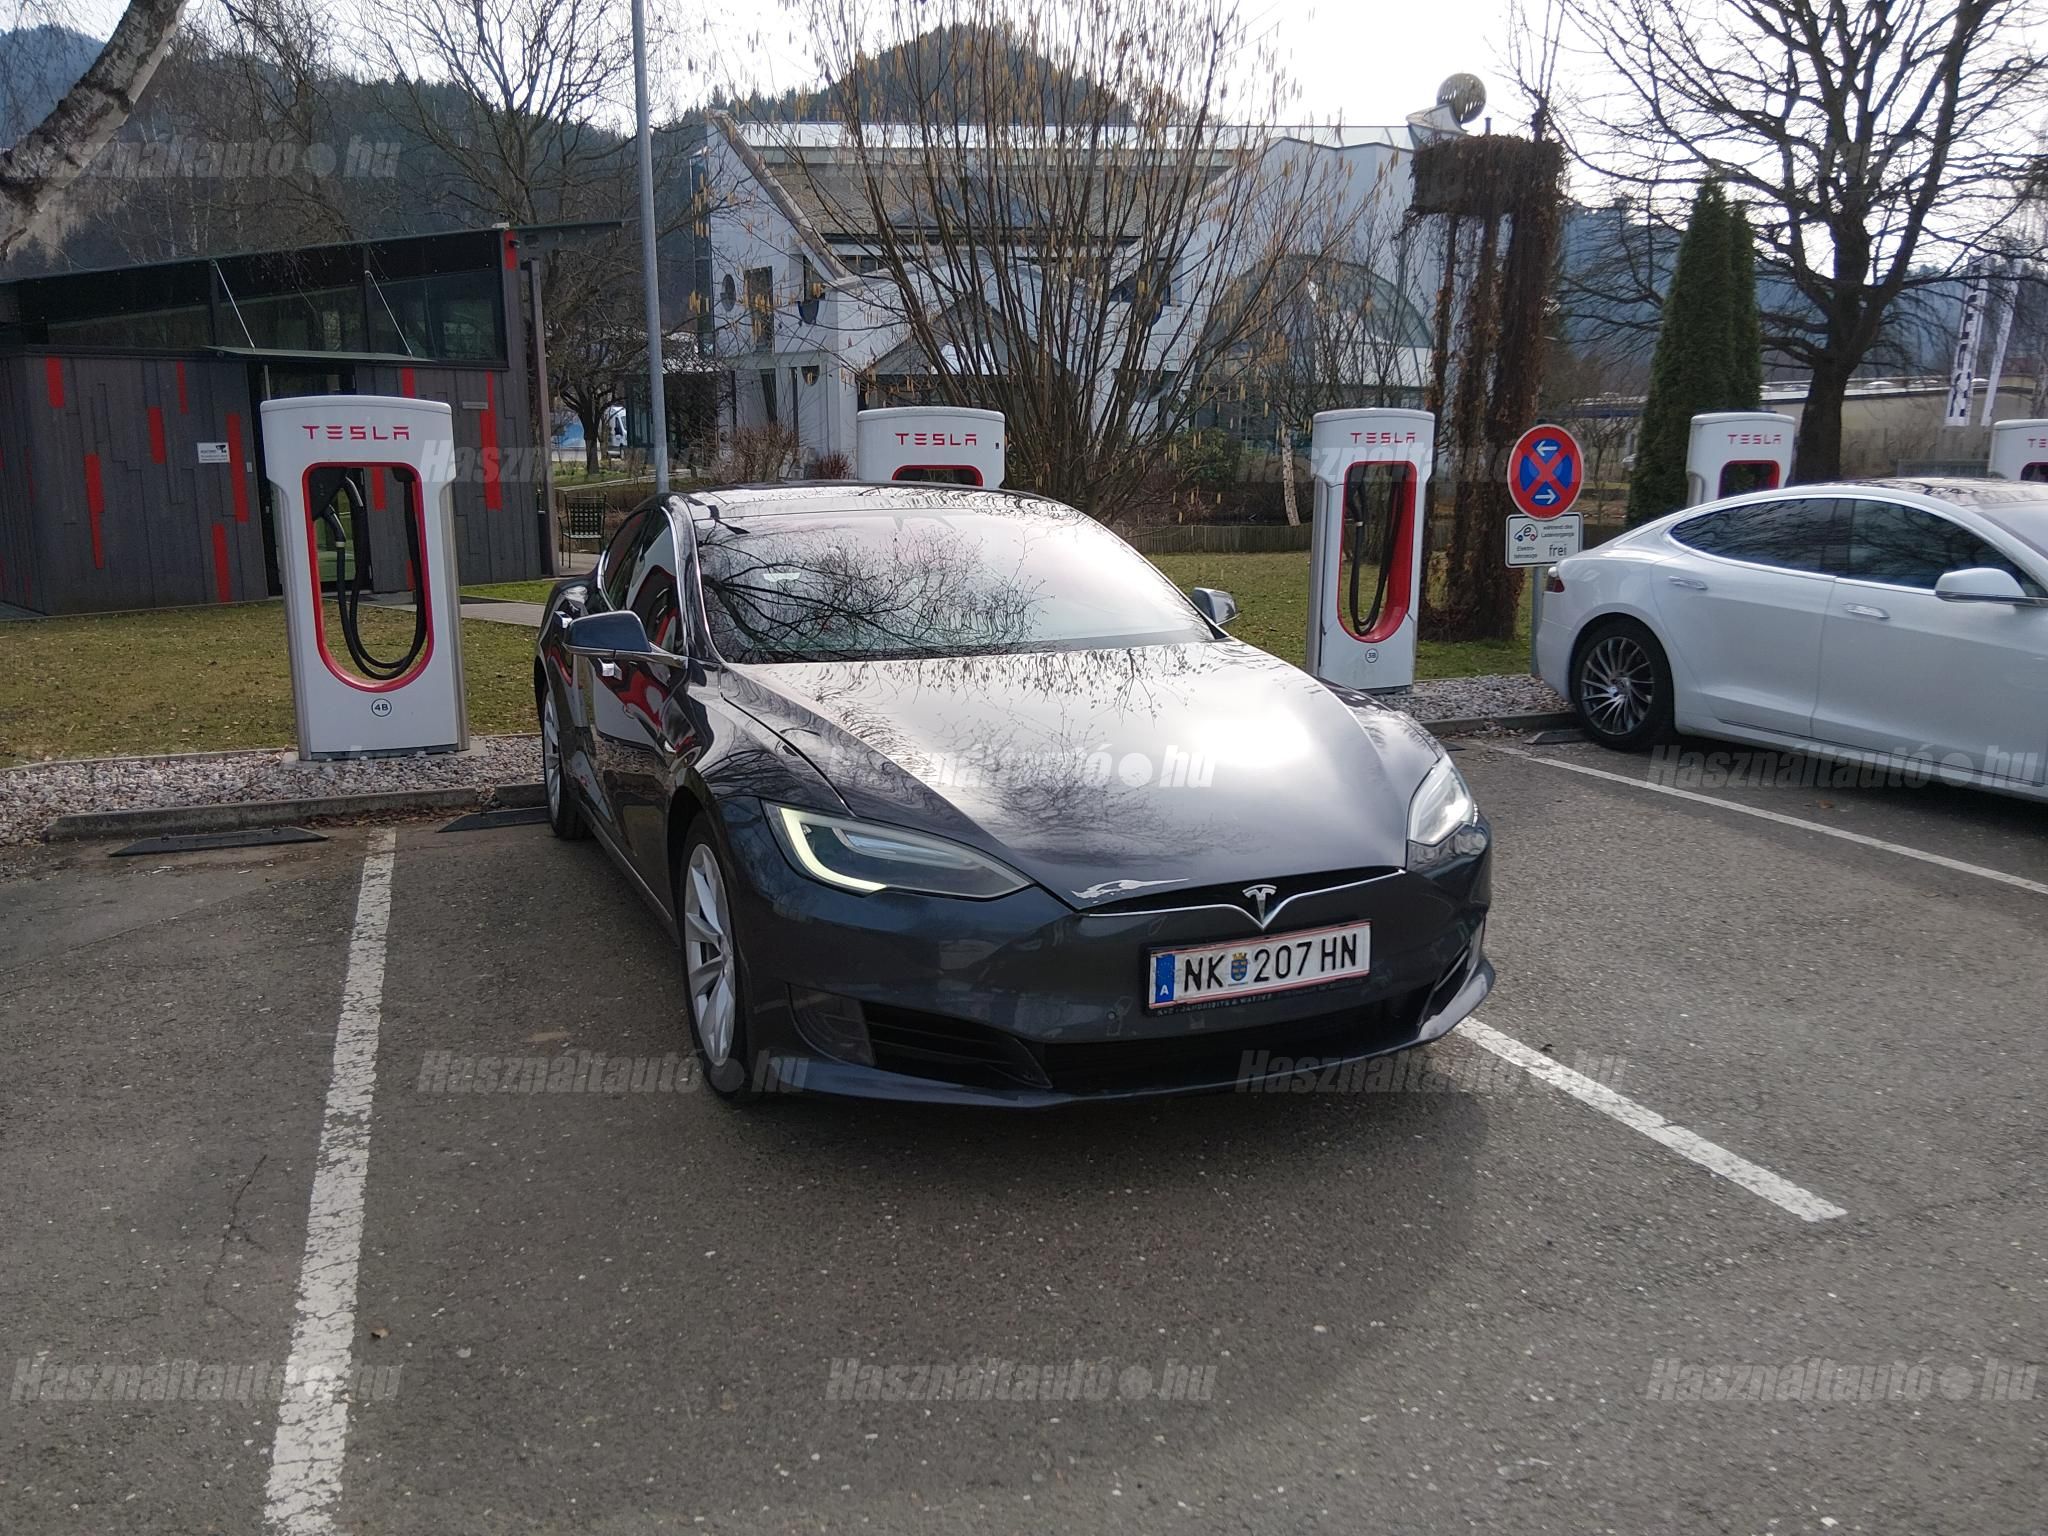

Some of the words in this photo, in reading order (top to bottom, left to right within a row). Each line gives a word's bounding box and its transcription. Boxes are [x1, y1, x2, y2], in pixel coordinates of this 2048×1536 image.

[301, 425, 410, 440] TESLA
[895, 432, 977, 446] TESLA
[1350, 432, 1416, 444] TESLA
[1727, 434, 1781, 445] TESLA
[1548, 544, 1567, 557] frei
[1160, 984, 1170, 997] A
[1183, 954, 1226, 992] NK
[1253, 940, 1313, 983] 207
[1320, 933, 1358, 972] HN
